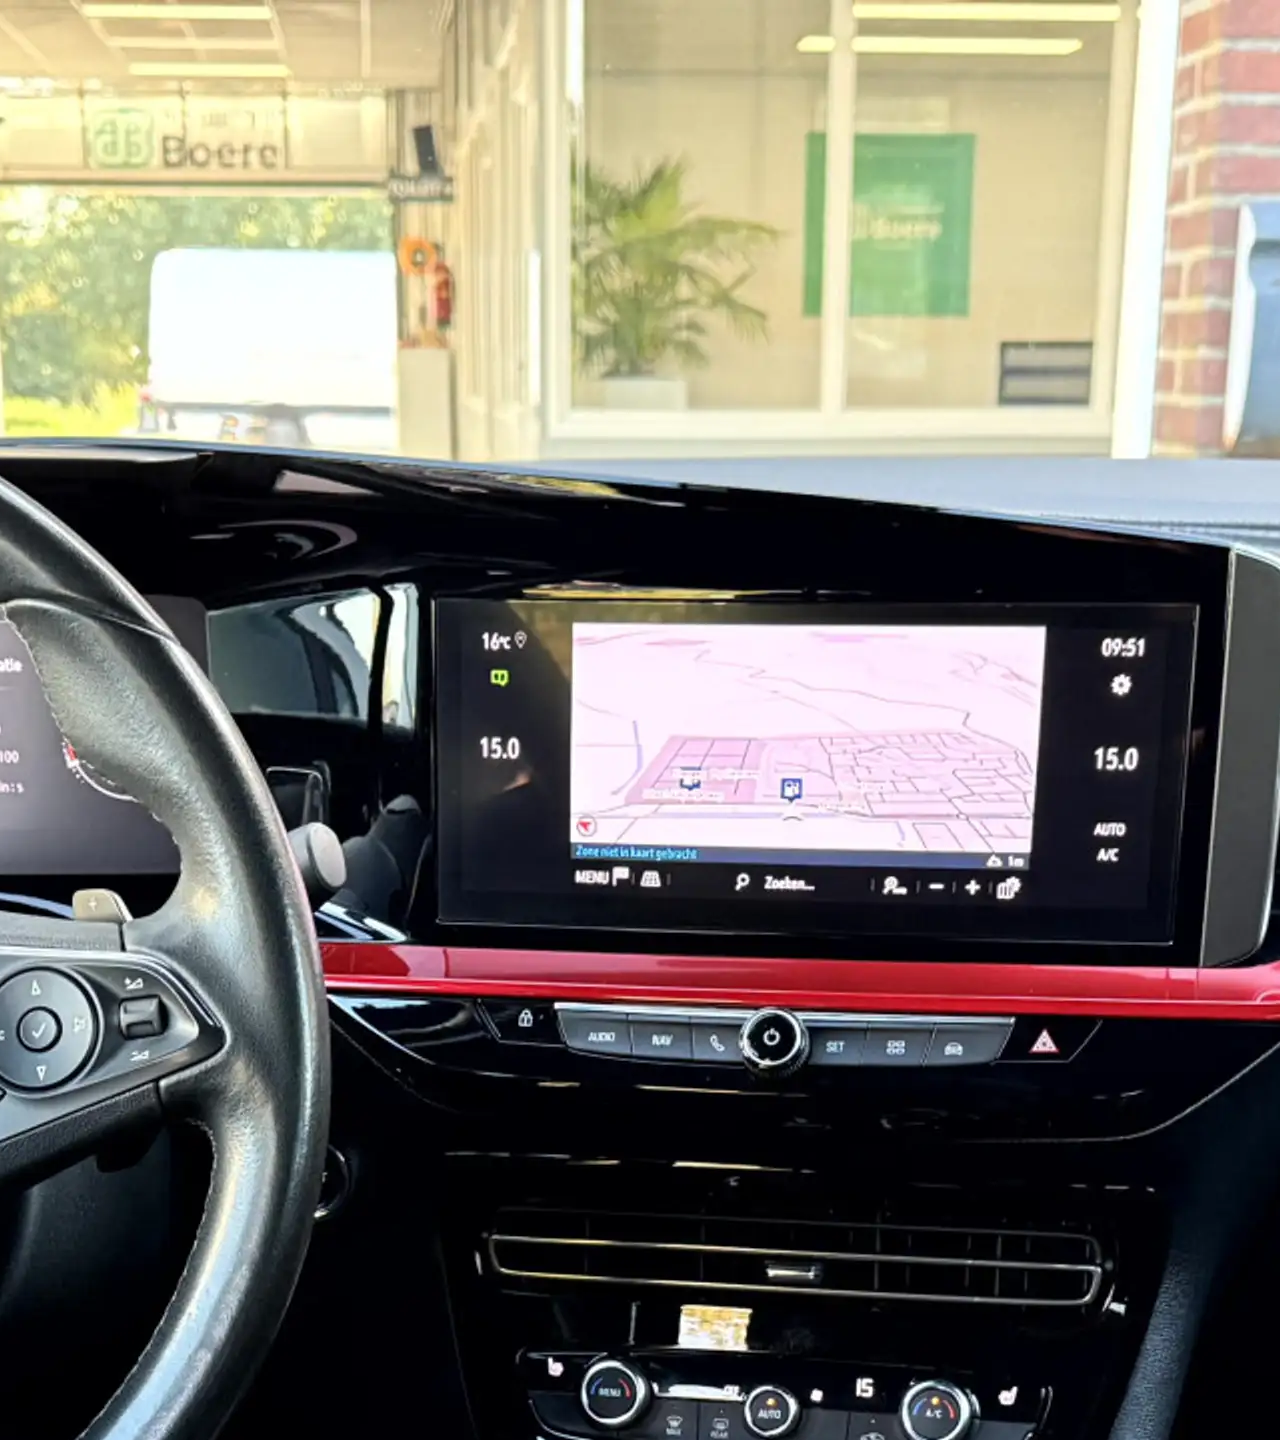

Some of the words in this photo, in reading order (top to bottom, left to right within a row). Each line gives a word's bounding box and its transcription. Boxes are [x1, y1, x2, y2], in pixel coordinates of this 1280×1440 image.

[161, 135, 278, 168] Boere
[1101, 638, 1145, 657] 09:51
[480, 737, 520, 760] 15.0
[1094, 748, 1139, 771] 15.0
[1094, 823, 1127, 837] AUTO
[575, 845, 599, 857] Zone
[600, 845, 619, 858] niet
[620, 846, 629, 857] in
[630, 846, 654, 858] kaart
[655, 847, 697, 861] gebracht
[1096, 848, 1120, 862] A/C
[574, 869, 609, 884] MENU
[588, 1032, 615, 1043] AUDIO
[652, 1035, 673, 1046] NAV
[826, 1041, 845, 1053] SET
[855, 1377, 875, 1397] 15
[757, 1409, 782, 1420] AUTO
[925, 1409, 943, 1420] A/C
